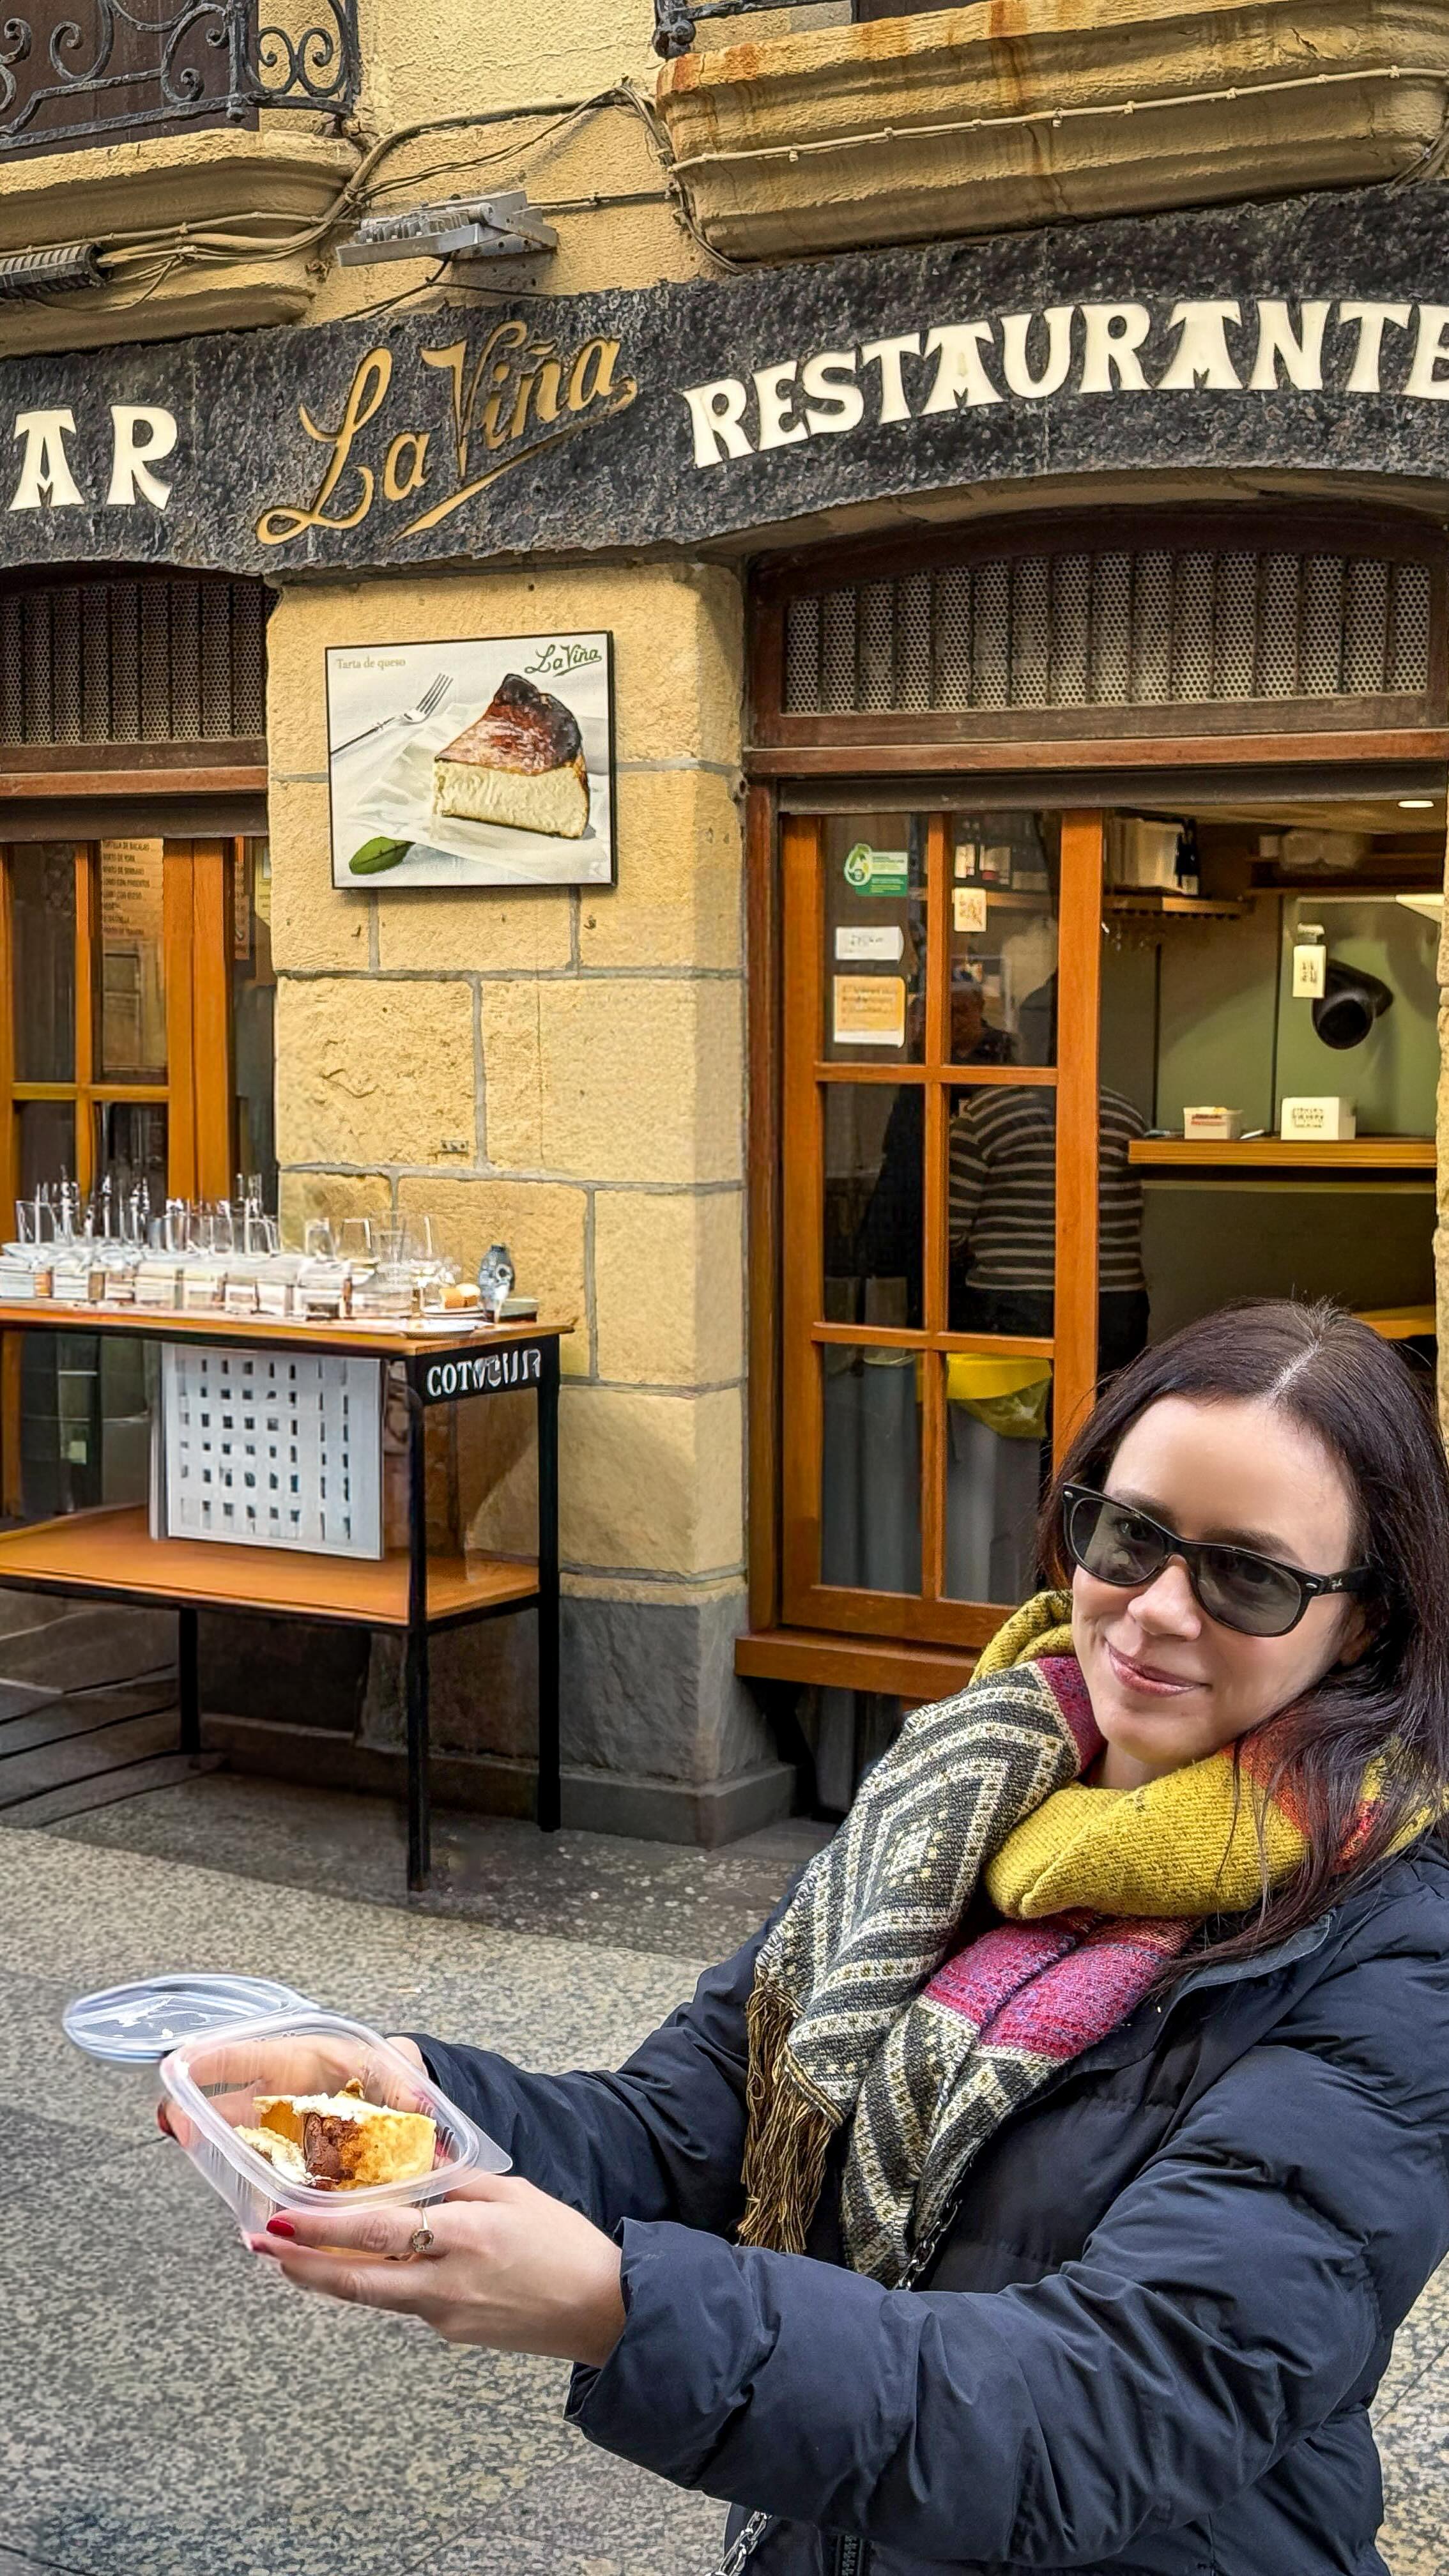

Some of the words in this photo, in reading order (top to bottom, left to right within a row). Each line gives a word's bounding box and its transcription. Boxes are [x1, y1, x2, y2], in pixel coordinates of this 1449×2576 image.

[257, 347, 430, 545] La
[418, 321, 638, 483] Viña
[682, 300, 1449, 470] RESTAURANTE
[336, 659, 361, 670] Tarta
[363, 655, 376, 668] de
[377, 658, 406, 671] queso
[524, 643, 563, 674] La
[559, 644, 602, 670] Viña
